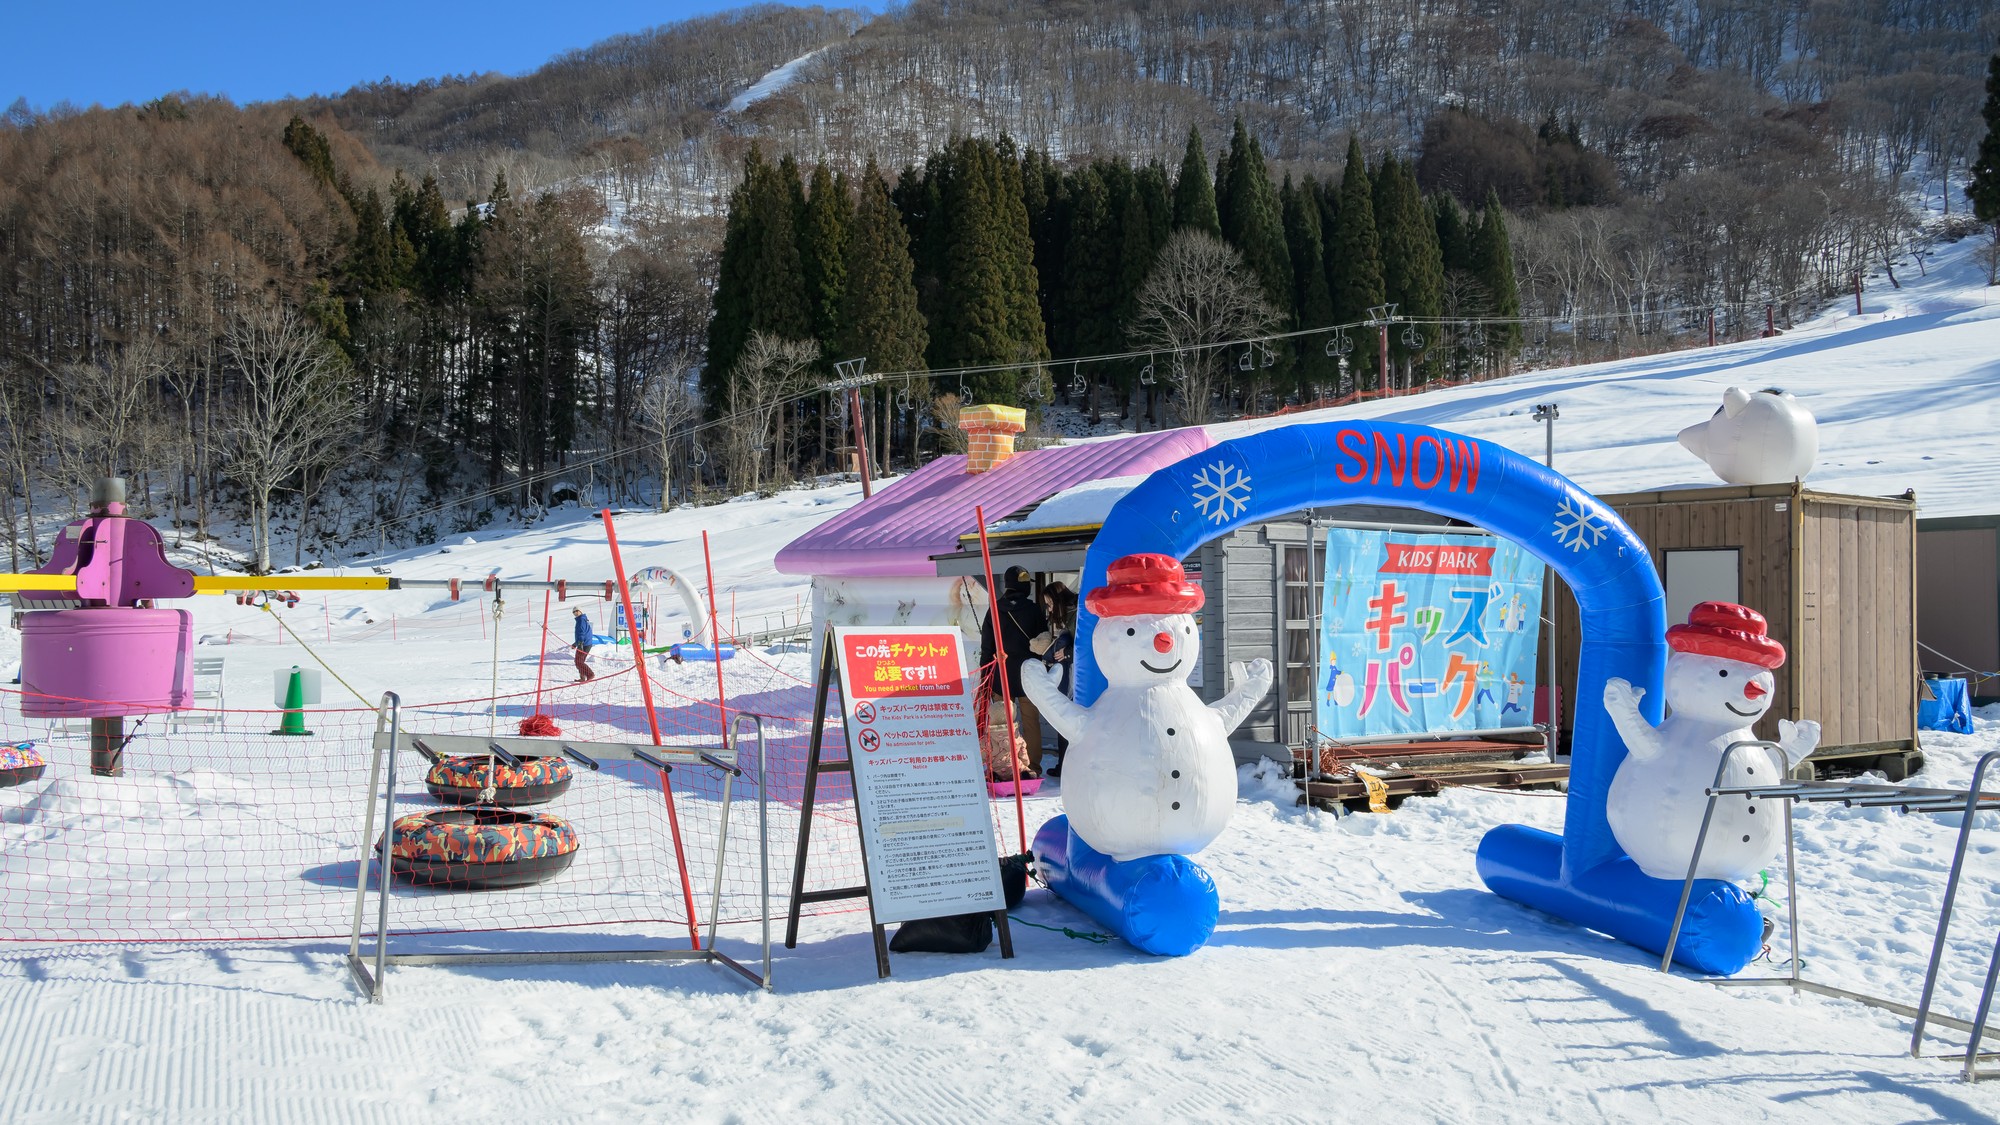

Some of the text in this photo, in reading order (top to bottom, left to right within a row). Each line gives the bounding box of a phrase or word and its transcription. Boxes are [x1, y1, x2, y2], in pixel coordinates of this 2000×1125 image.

[1336, 430, 1480, 494] SNOW
[1398, 551, 1478, 569] KIDS PARK
[1365, 581, 1502, 651] キッズ
[855, 643, 949, 658] この先チケットが
[864, 685, 876, 693] You
[1357, 643, 1480, 721] パーク
[880, 702, 964, 713] キッズパーク内は禁煙です。
[883, 727, 972, 739] ペットのご入場は出来ません。
[868, 754, 968, 766] キッズパークご利用のお客様へお願い
